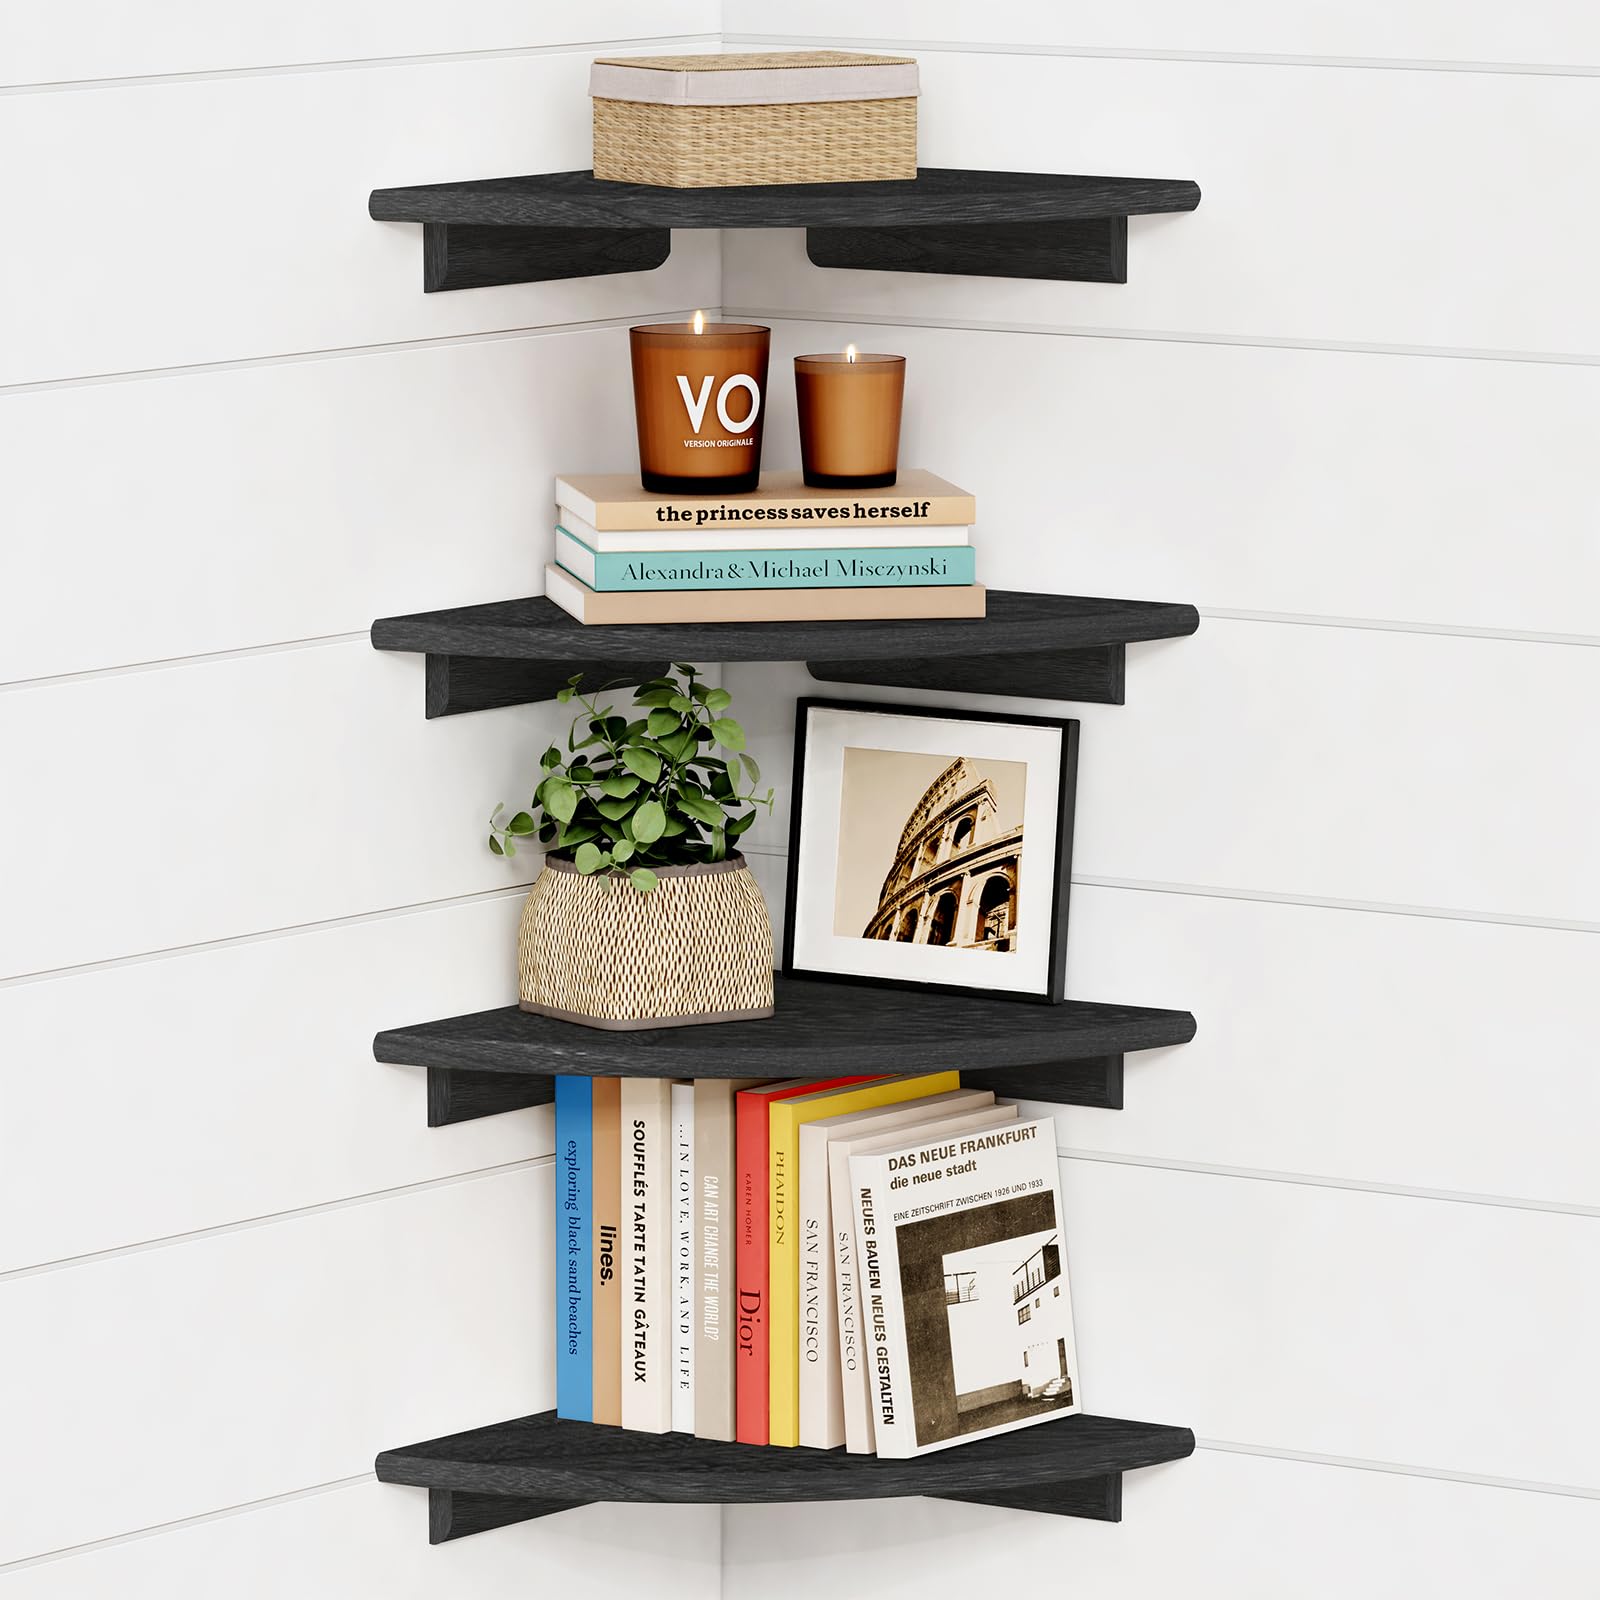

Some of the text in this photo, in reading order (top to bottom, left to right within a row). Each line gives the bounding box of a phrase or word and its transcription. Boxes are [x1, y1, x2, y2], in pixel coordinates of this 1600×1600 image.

[676, 374, 760, 434] VO
[656, 502, 931, 525] the princess saves herself
[621, 557, 948, 582] Alexandra & Michael Misczynski
[888, 1126, 1037, 1171] DAS NEUE FRANKFURT
[890, 1160, 977, 1190] die neue stadt
[744, 1174, 752, 1247] KAREN HOMER
[776, 1151, 785, 1246] PHAIDON
[893, 1178, 1044, 1221] EINE ZEITSCHRIFT ZWISCHEN 1926 UND 1933
[564, 1140, 581, 1355] exploring black sand beaches
[600, 1225, 617, 1286] lines.
[633, 1119, 650, 1383] SOUFFLÉS TARTE TATIN GÂTEAUX
[703, 1175, 720, 1341] CAN ART CHANGE THE WORLD?
[680, 1296, 690, 1335] AND
[740, 1288, 761, 1356] Dior
[805, 1219, 819, 1363] SAN FRANCISCO
[838, 1232, 857, 1372] SAN FRANCISCO
[860, 1188, 895, 1425] NEUES BAUEN NEUES GESTALTEN
[680, 1346, 690, 1390] LIFE
